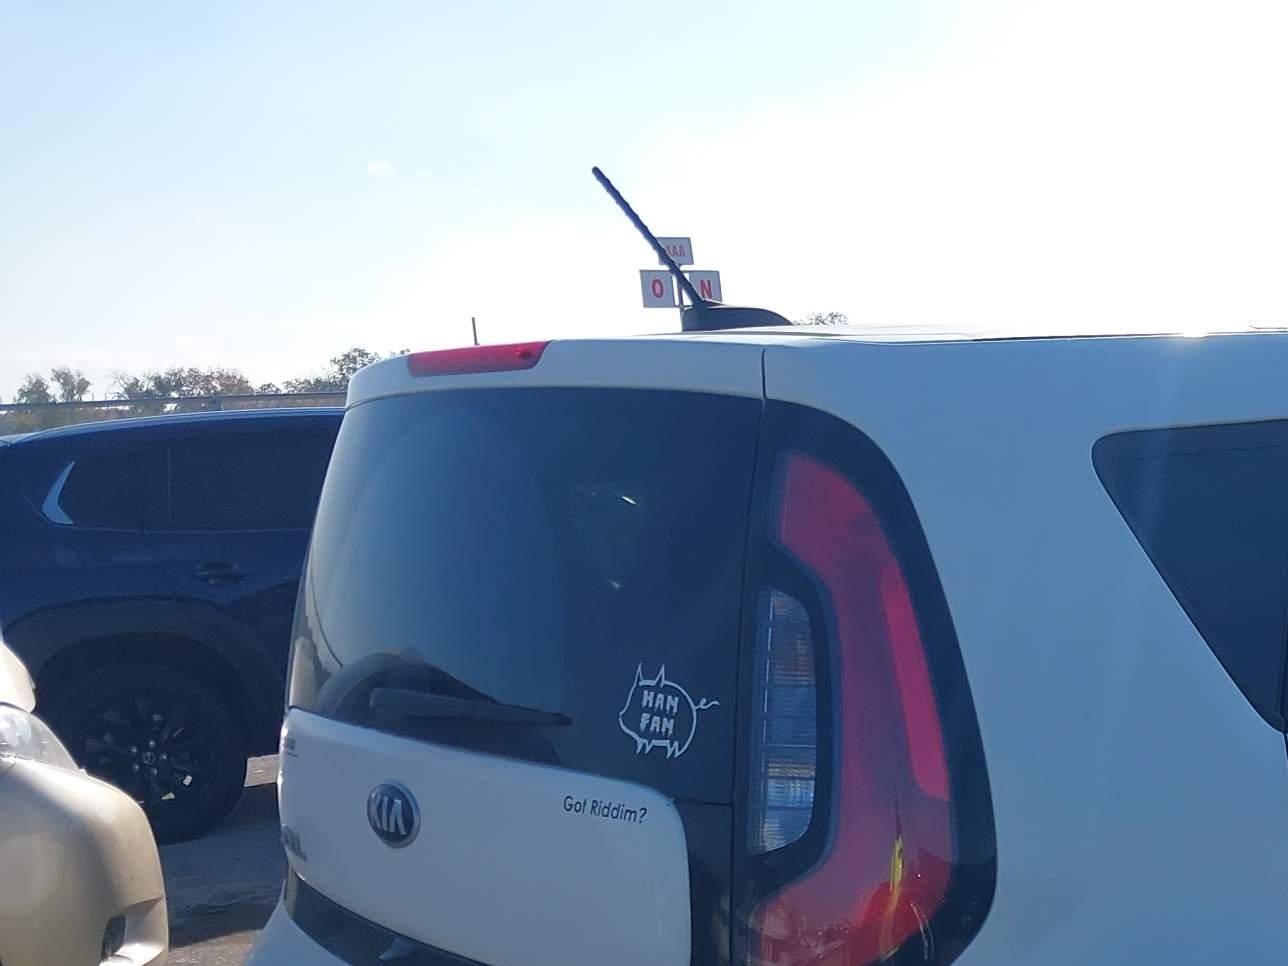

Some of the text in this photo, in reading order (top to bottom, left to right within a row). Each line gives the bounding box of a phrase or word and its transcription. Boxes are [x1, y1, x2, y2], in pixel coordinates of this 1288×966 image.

[651, 278, 664, 298] O
[700, 279, 713, 299] N
[642, 690, 679, 715] HAM
[640, 713, 675, 736] FAM
[370, 793, 408, 836] KIA
[563, 795, 648, 824] Got Riddim?
